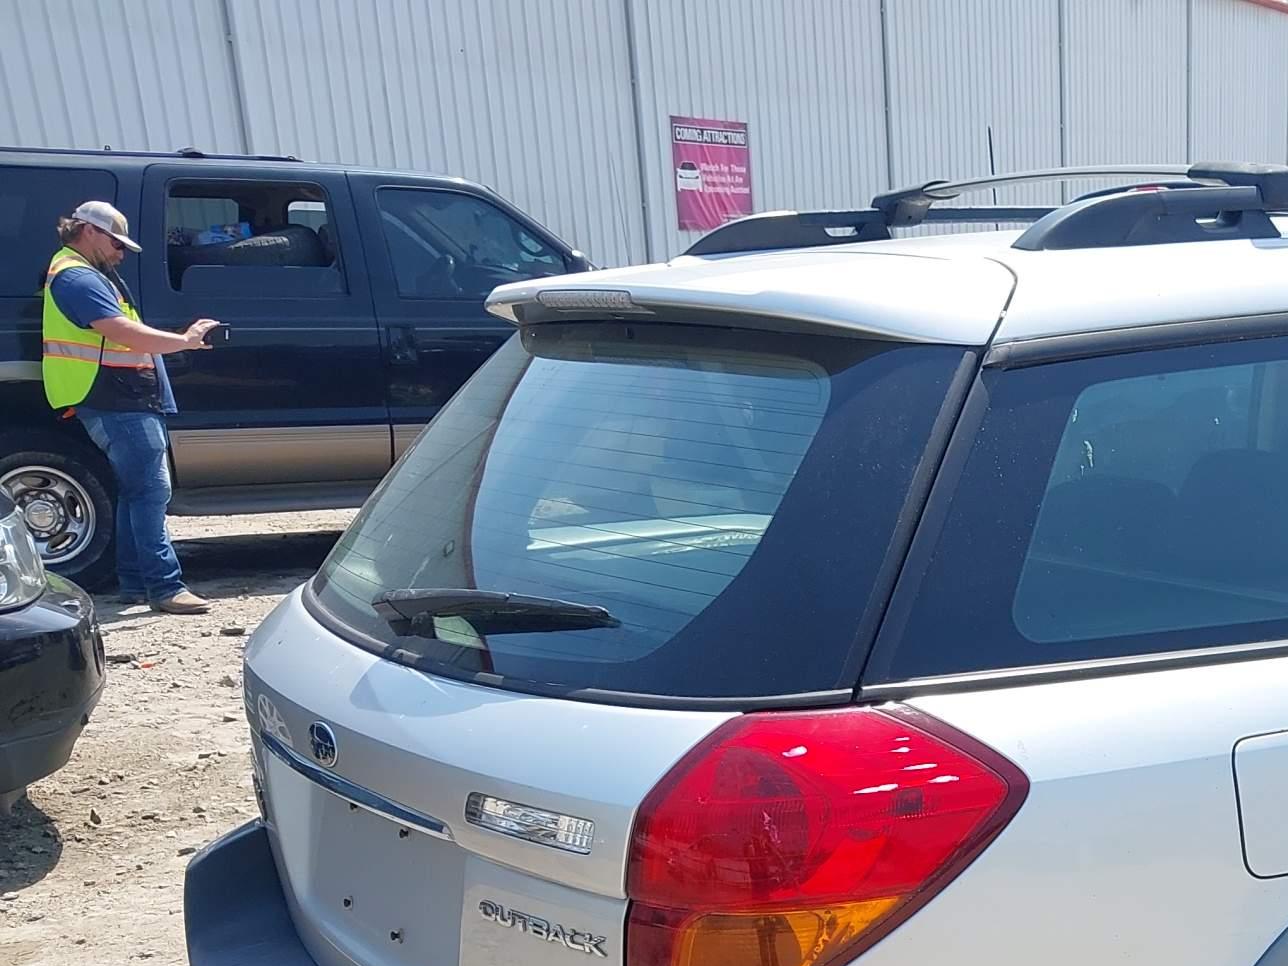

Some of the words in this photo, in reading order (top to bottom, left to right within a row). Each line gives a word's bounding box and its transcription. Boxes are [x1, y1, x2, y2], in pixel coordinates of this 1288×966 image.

[675, 127, 702, 140] COMING
[703, 130, 746, 144] ATTRACTIONS
[479, 899, 608, 957] OUTBACK
